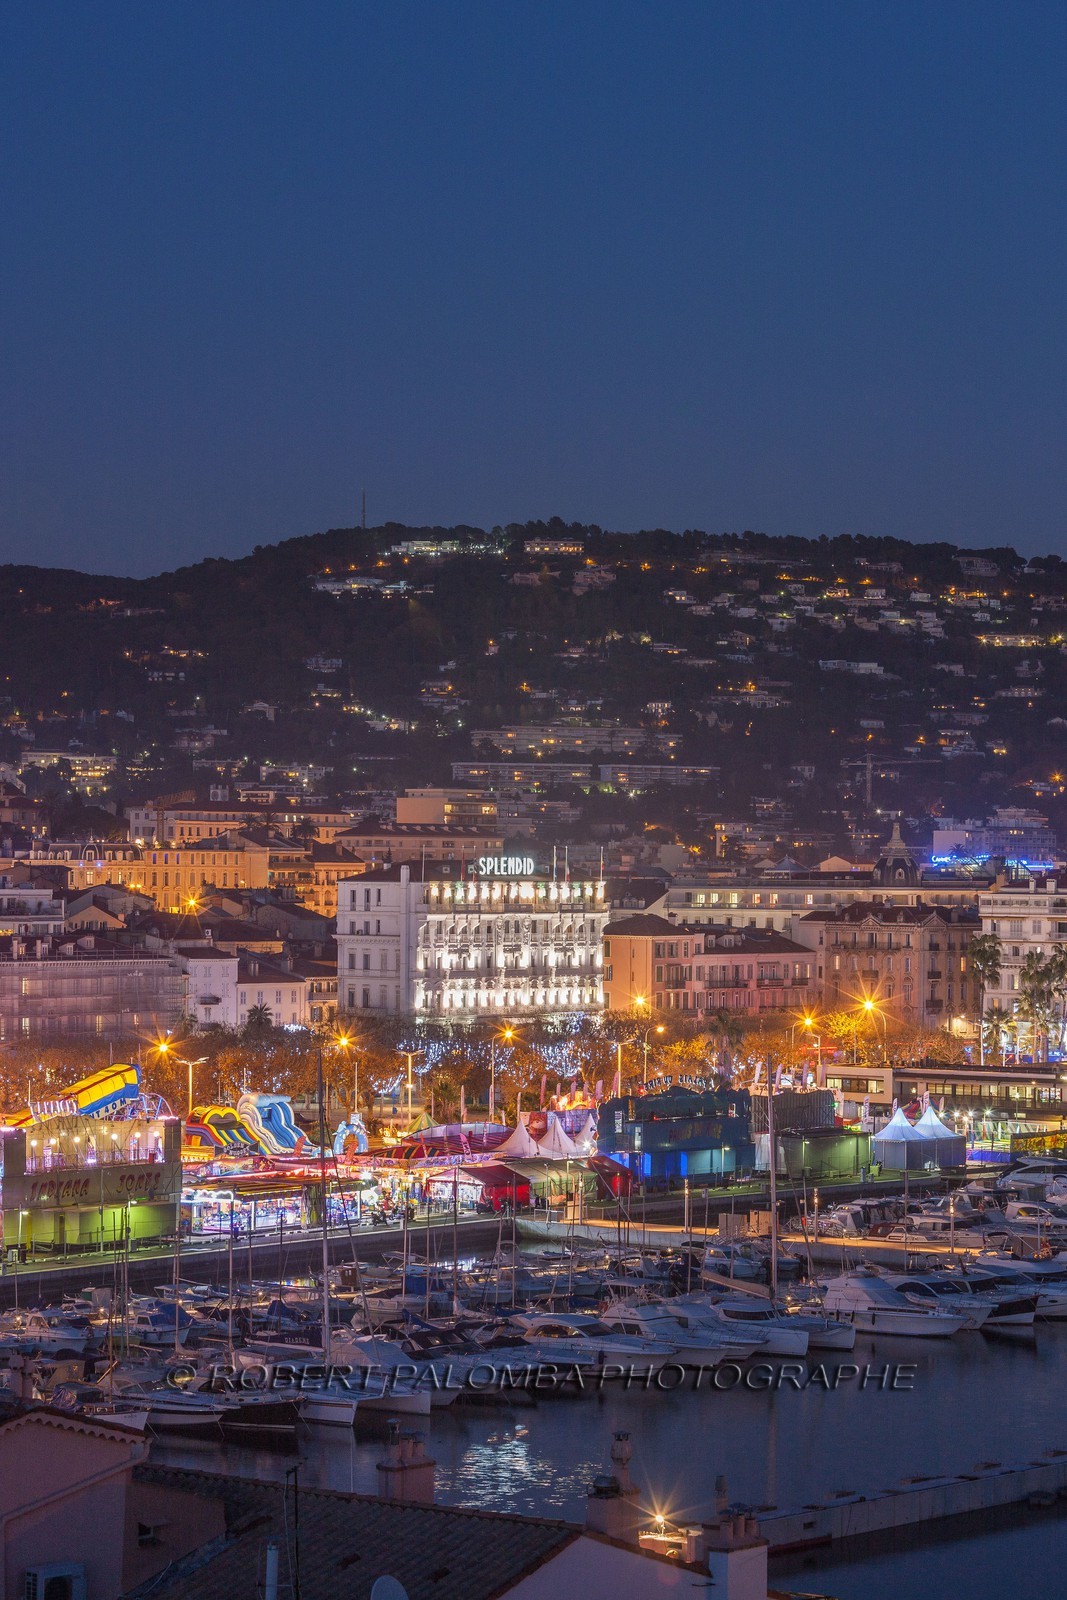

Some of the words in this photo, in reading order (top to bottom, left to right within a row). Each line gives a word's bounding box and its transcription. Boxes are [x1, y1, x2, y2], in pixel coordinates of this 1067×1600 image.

[479, 857, 534, 875] SPLENDID
[30, 1178, 90, 1201] INDIANA
[116, 1172, 161, 1193] JONES
